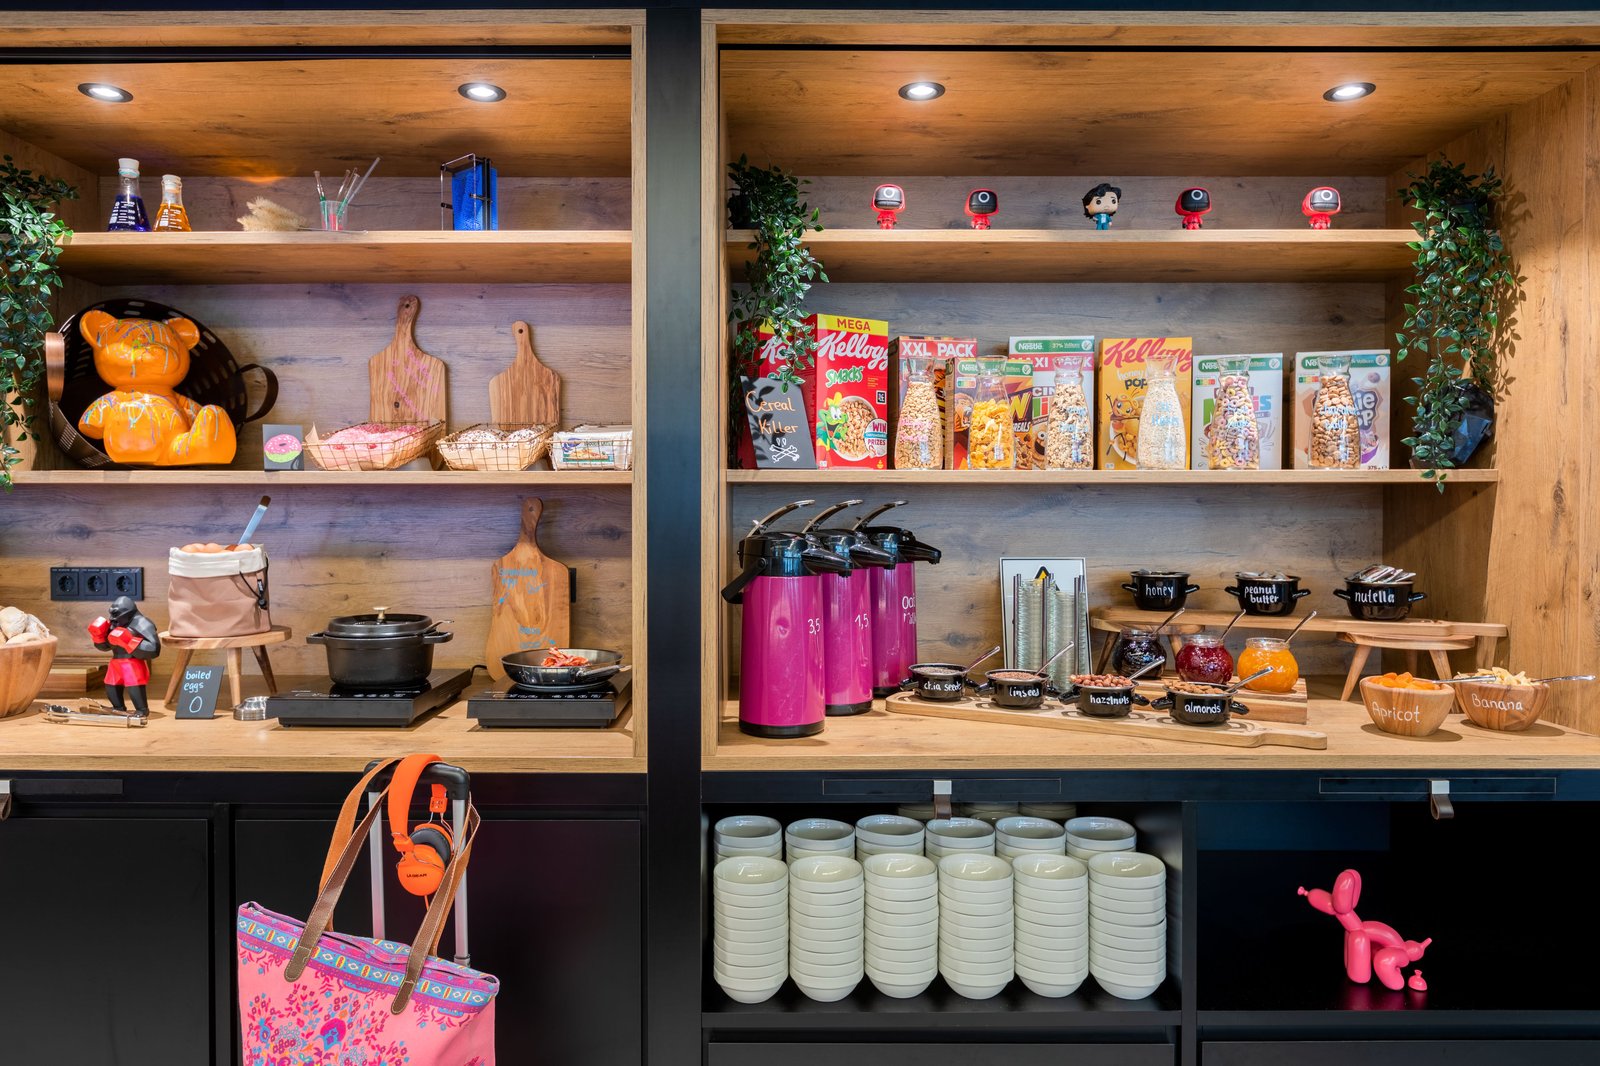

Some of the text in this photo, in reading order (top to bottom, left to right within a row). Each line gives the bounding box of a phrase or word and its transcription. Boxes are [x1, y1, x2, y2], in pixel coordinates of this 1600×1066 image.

[837, 318, 871, 331] MEGA
[902, 342, 975, 357] XXL PACK
[1125, 378, 1147, 390] pop
[746, 390, 796, 413] Cereal
[759, 419, 798, 435] Killer
[872, 421, 887, 433] WIN
[868, 438, 886, 446] PRIZES
[1145, 583, 1174, 599] honey
[1244, 584, 1276, 598] peanut
[1354, 589, 1395, 603] nutella
[1250, 594, 1279, 604] butter
[807, 617, 821, 635] 3,5
[854, 613, 869, 630] 1,5
[185, 669, 212, 680] boiled
[183, 681, 204, 694] eggs
[1009, 685, 1040, 698] linseed
[1089, 694, 1130, 705] hazelnuts
[1471, 693, 1523, 711] Banana
[1184, 701, 1221, 714] almonds
[1371, 701, 1420, 723] Apricot
